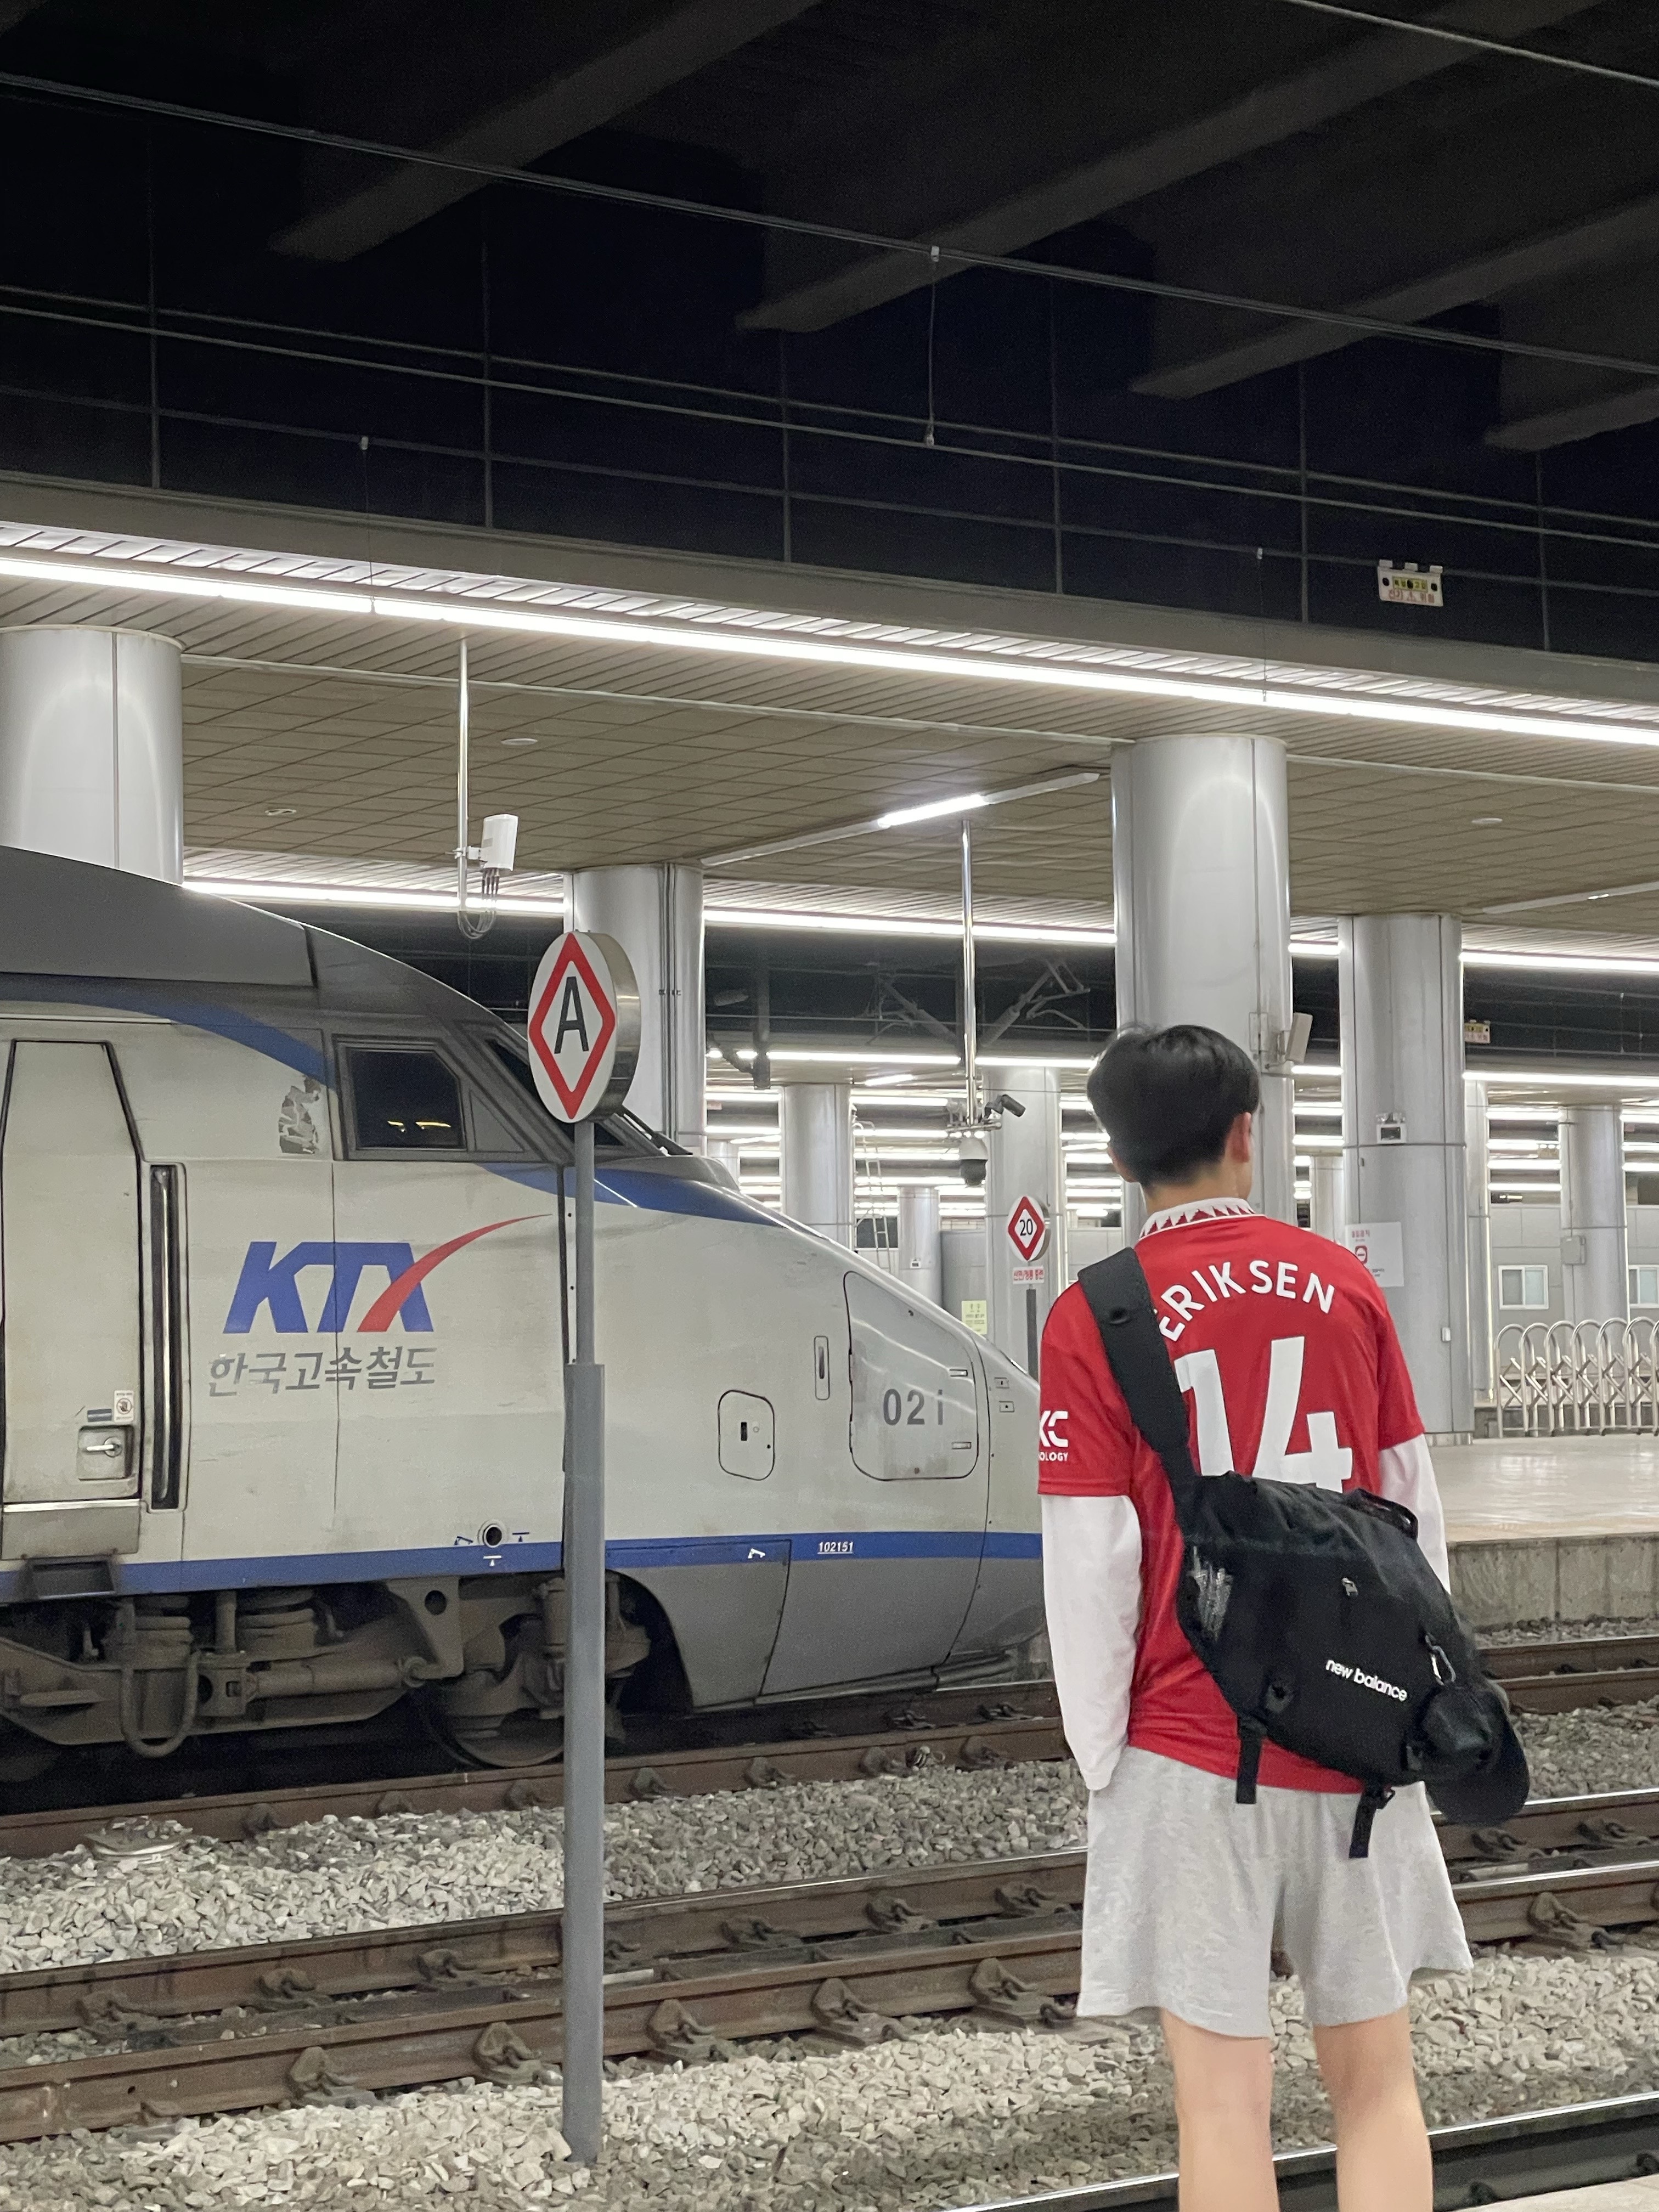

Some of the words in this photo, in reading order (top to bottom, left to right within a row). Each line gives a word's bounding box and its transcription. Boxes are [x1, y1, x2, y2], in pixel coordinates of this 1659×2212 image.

[554, 976, 589, 1054] A
[1019, 1218, 1033, 1237] 20
[223, 1228, 483, 1334] KTX
[1159, 1259, 1335, 1342] ERIKSEN
[208, 1346, 436, 1397] 한국고속철도
[1174, 1335, 1353, 1493] 14
[818, 1541, 854, 1553] 102151
[1325, 1660, 1353, 1679] new
[1353, 1667, 1408, 1702] balance
